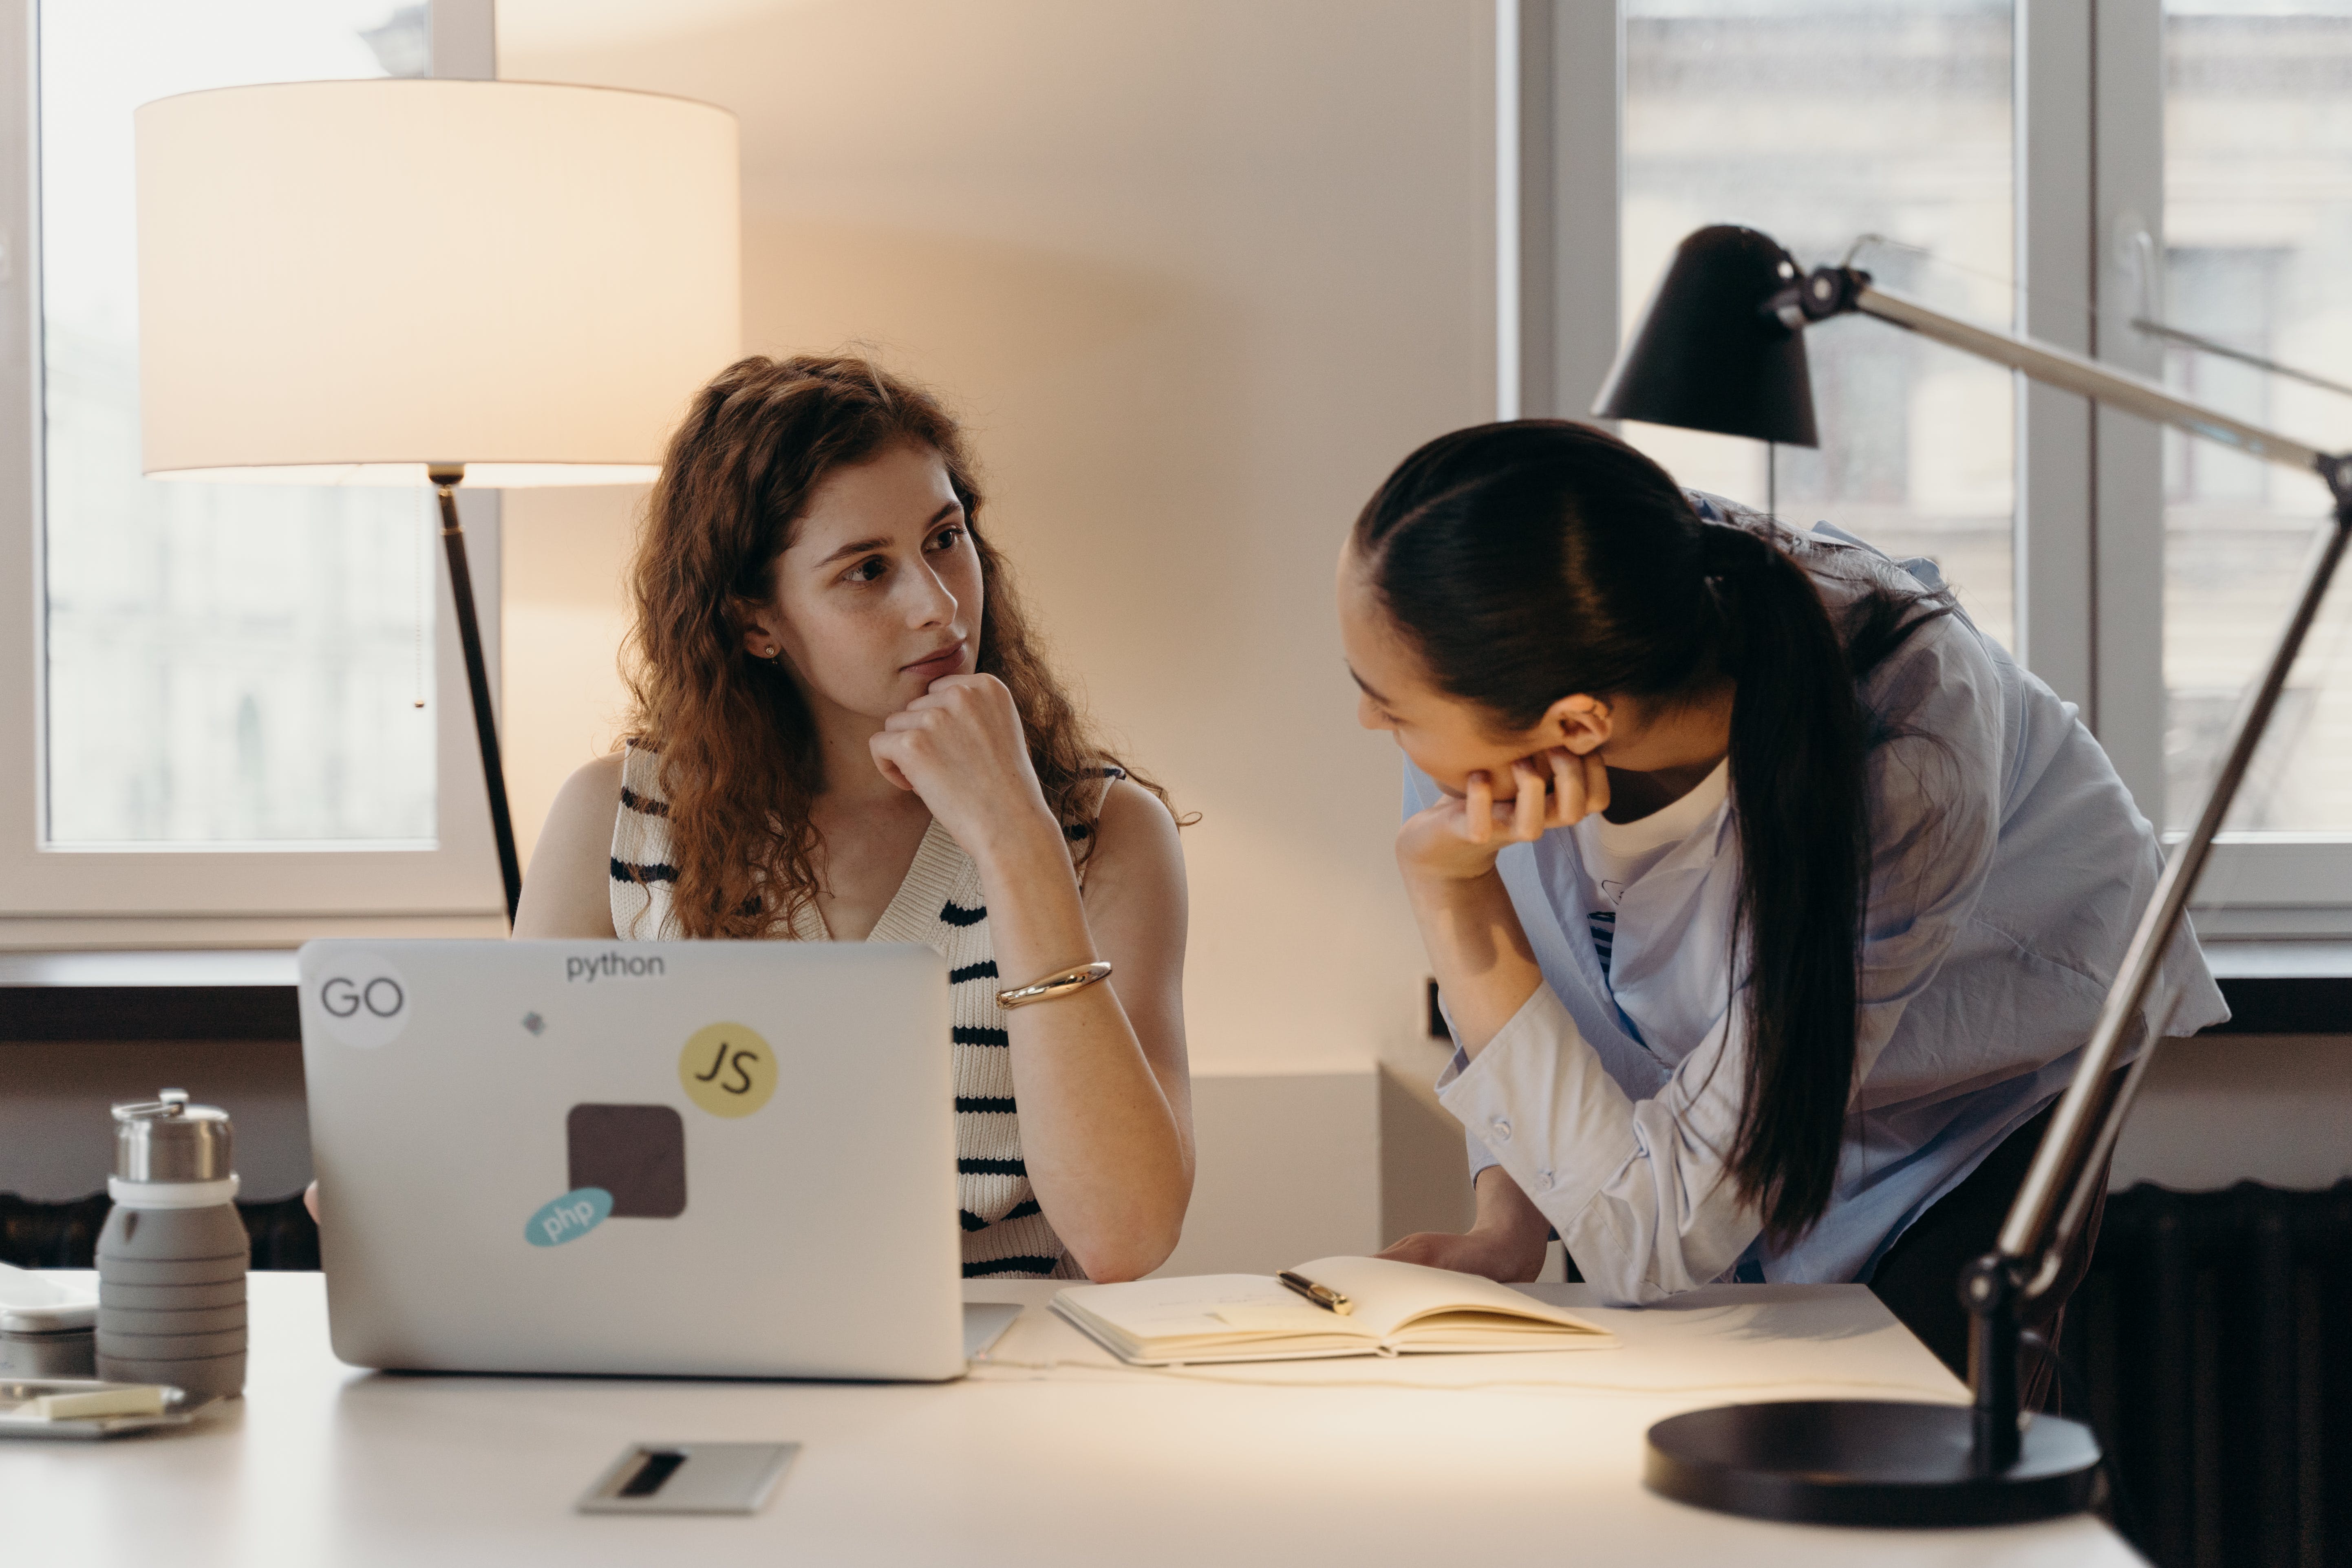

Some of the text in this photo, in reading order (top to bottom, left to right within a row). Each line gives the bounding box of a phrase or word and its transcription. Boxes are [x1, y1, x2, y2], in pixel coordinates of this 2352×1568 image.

[565, 951, 665, 982] python
[322, 977, 403, 1017] GO
[695, 1042, 759, 1095] JS
[542, 1200, 594, 1242] php
